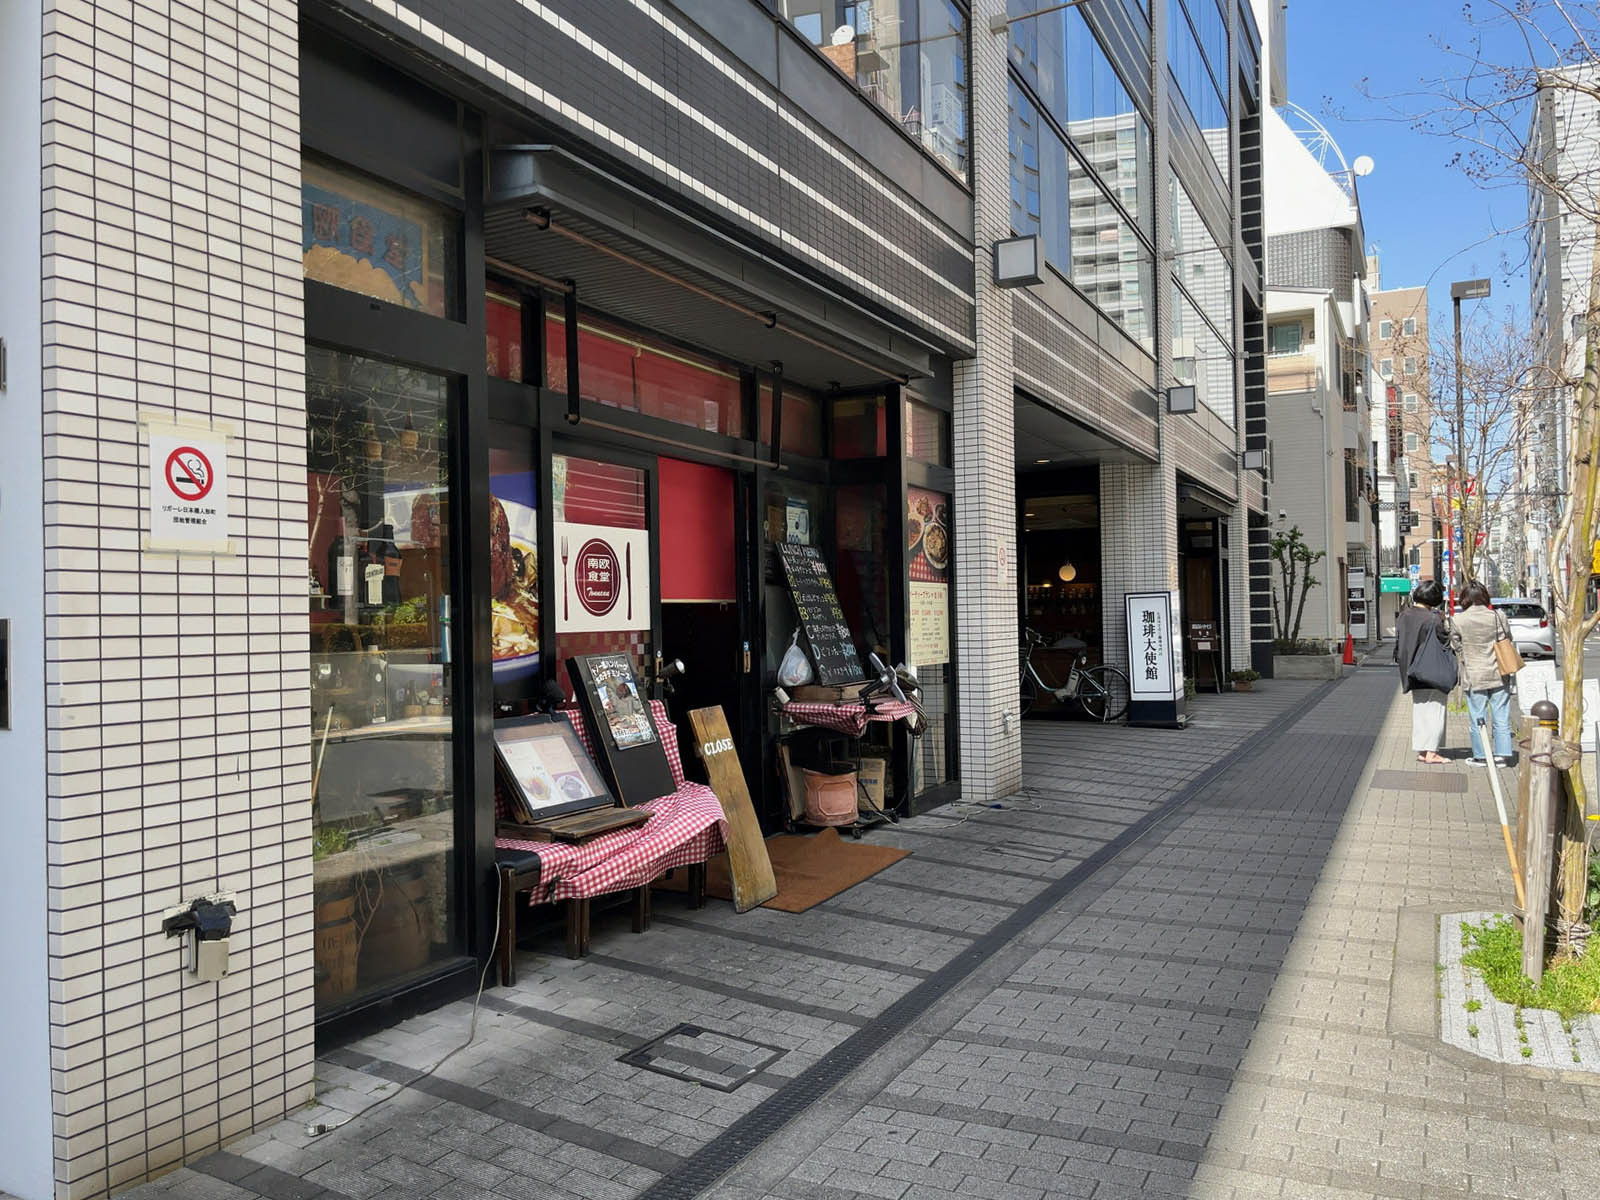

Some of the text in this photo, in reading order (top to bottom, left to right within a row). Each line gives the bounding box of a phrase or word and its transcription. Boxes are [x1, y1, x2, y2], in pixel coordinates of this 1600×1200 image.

[587, 558, 610, 570] 南欧
[587, 570, 610, 582] 食堂
[1142, 610, 1158, 681] 珈琲大使館
[704, 737, 734, 756] CLOSE
